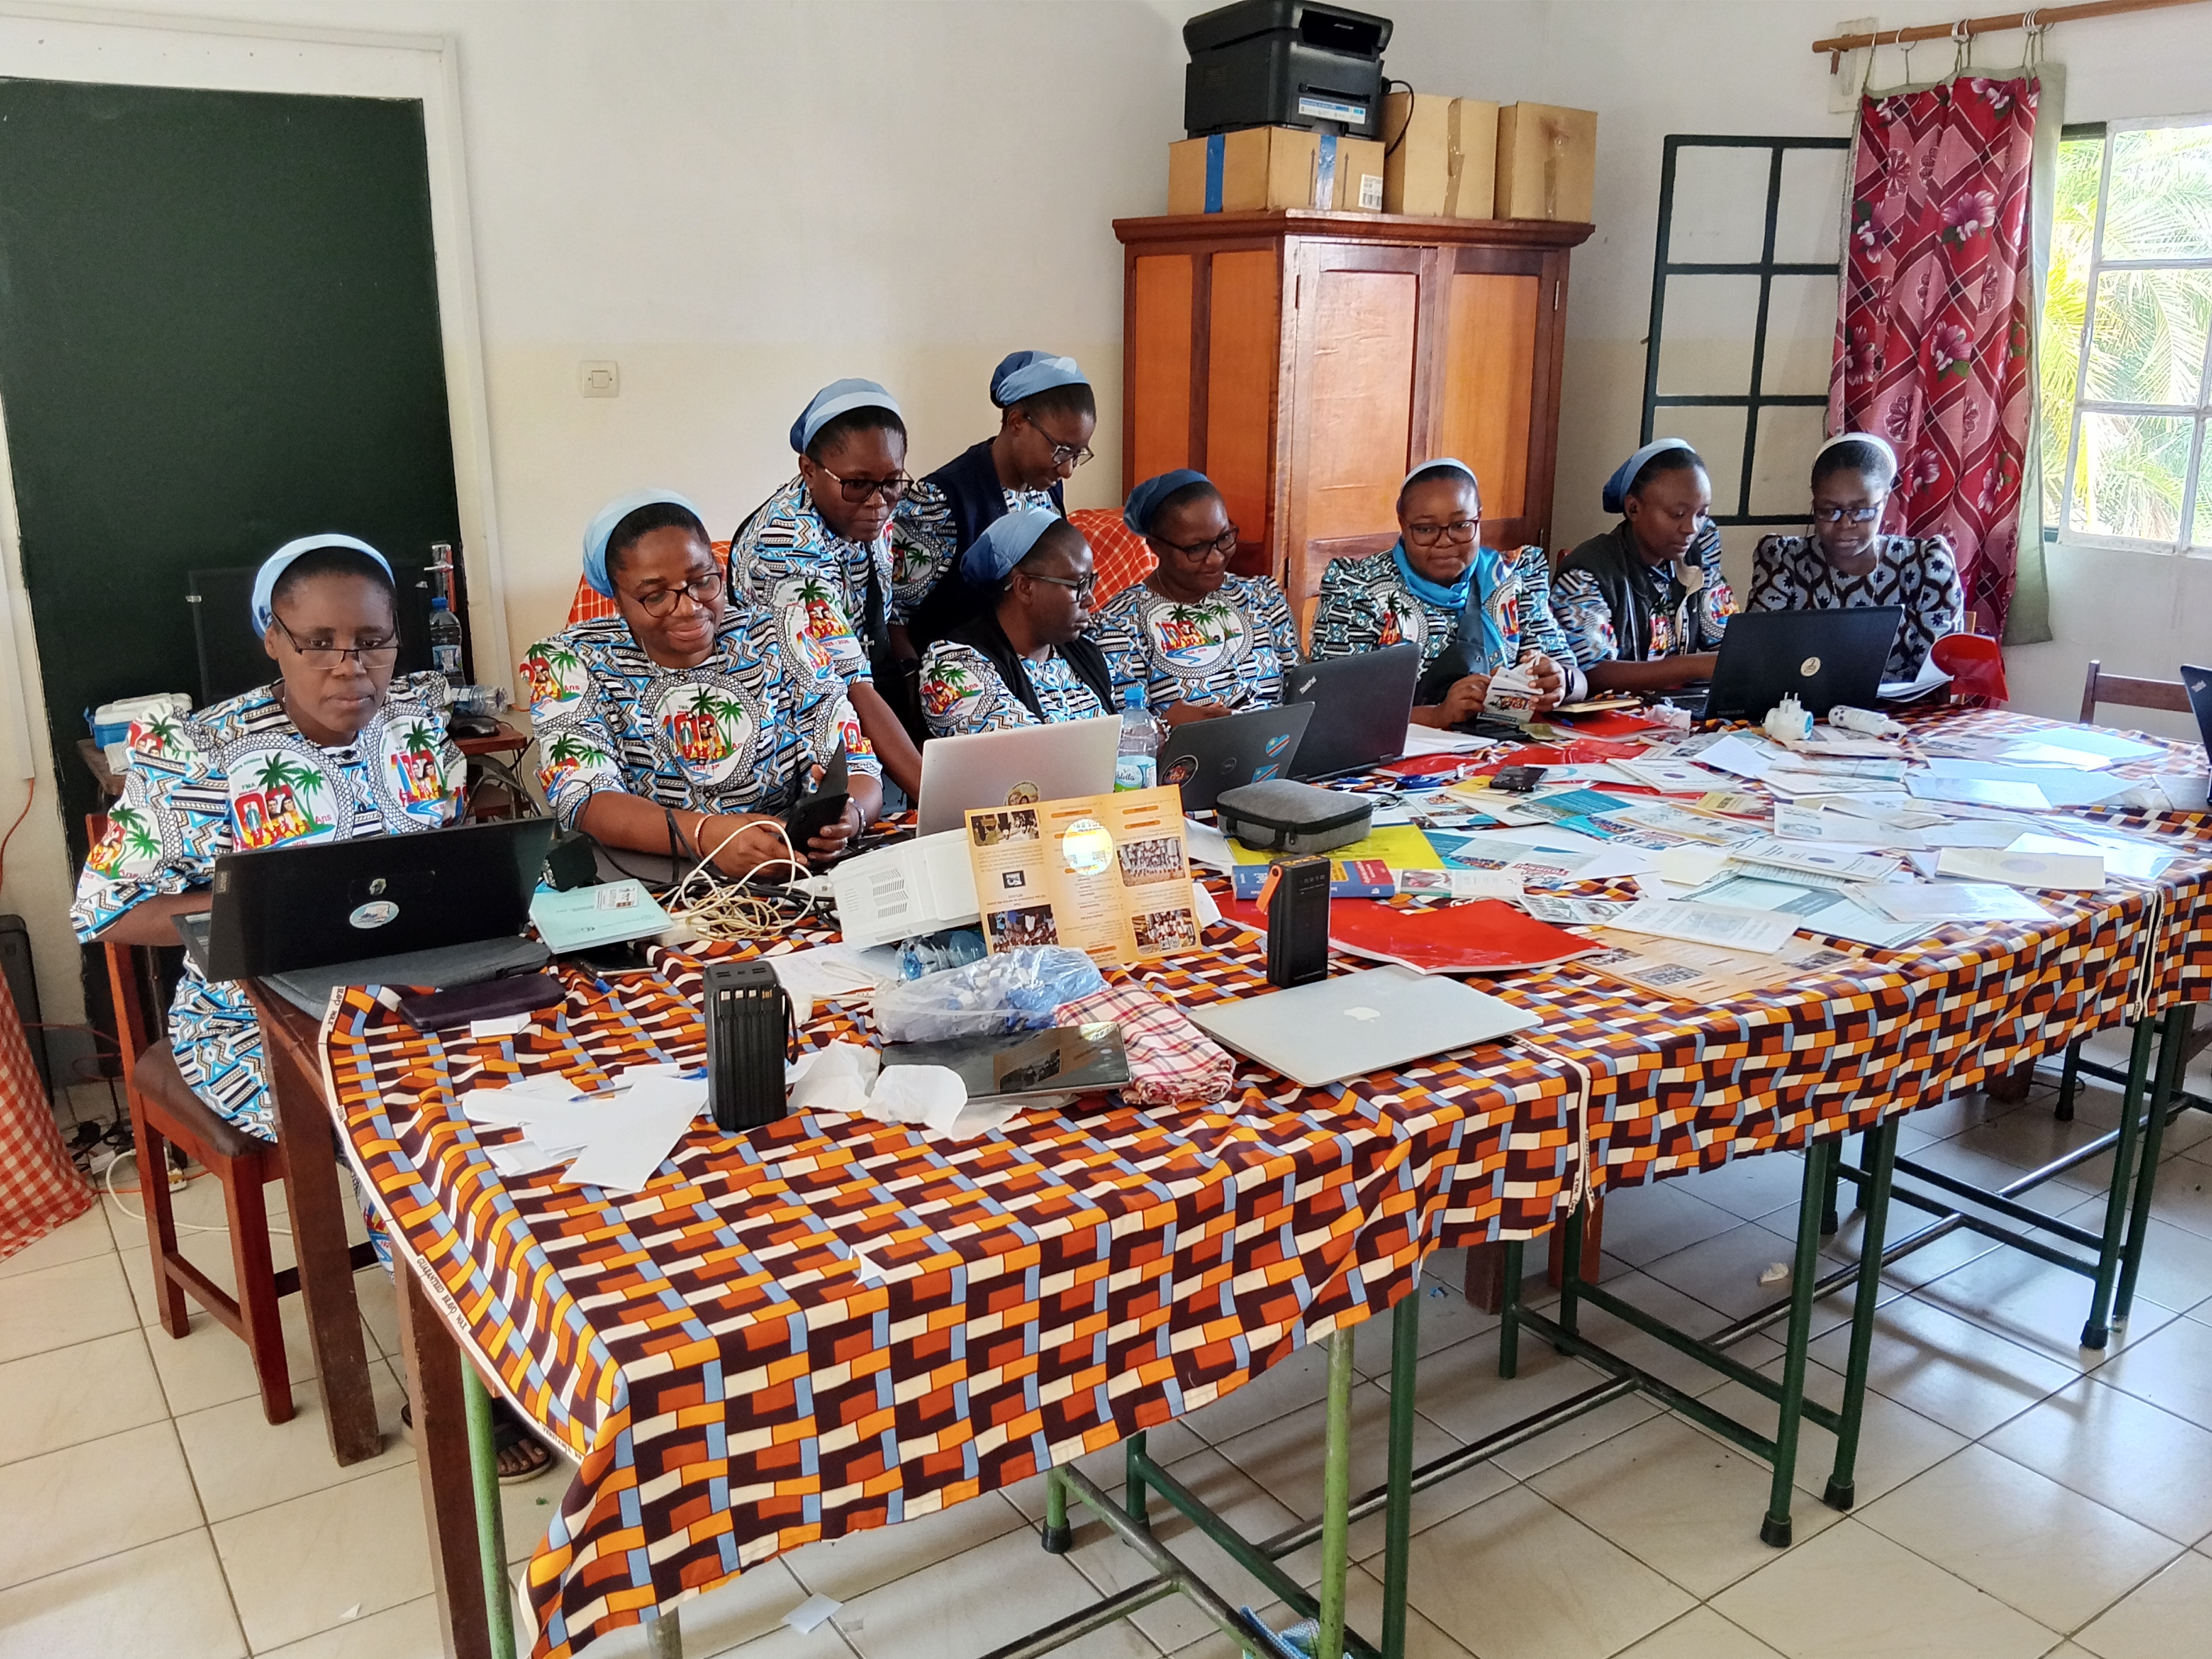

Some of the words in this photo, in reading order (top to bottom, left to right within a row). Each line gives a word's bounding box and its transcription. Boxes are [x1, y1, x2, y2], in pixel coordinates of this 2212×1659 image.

[964, 683, 979, 692] Ans
[732, 743, 743, 751] An
[315, 813, 332, 824] Ans
[327, 1010, 337, 1026] WAX
[417, 1258, 444, 1293] GUARANTEED
[442, 1294, 457, 1314] BRAVO
[456, 1314, 468, 1331] WAX
